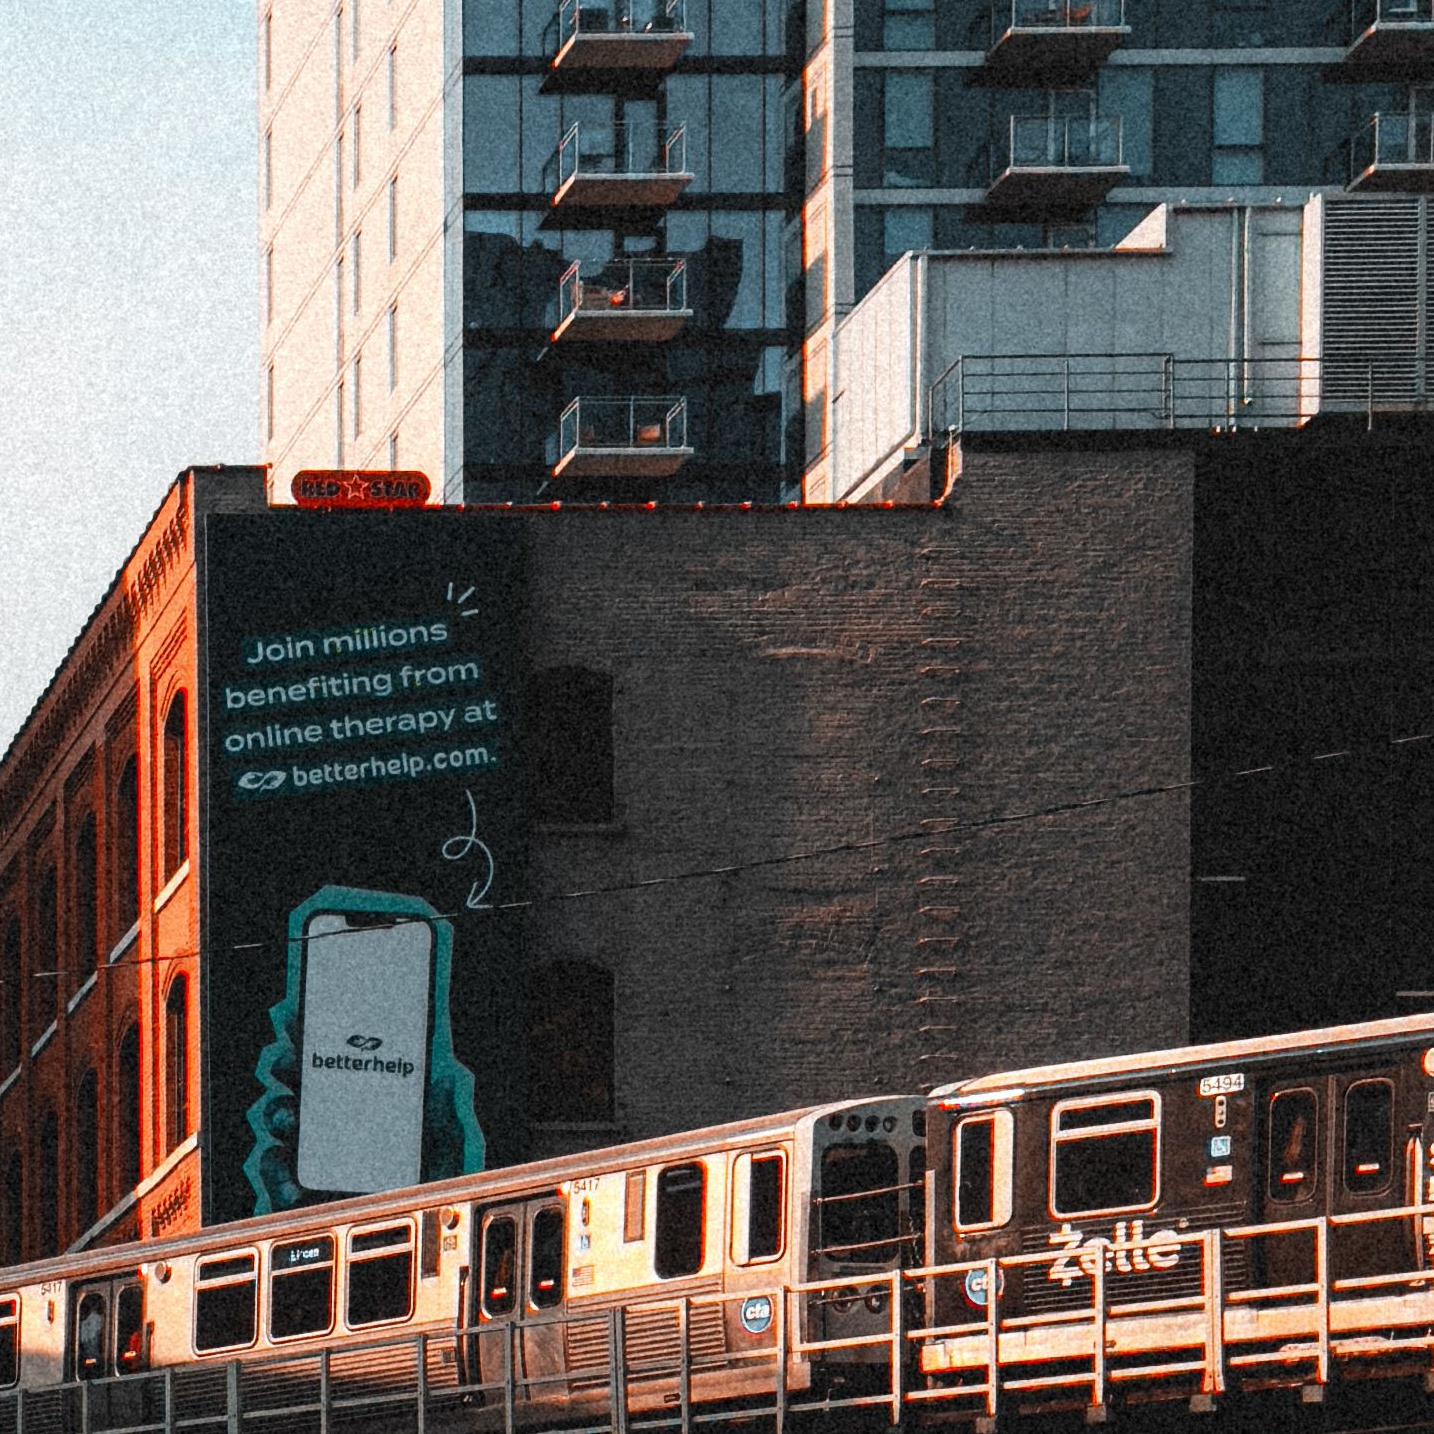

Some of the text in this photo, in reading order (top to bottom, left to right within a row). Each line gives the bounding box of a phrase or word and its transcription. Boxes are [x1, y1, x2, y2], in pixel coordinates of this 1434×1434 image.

[301, 479, 421, 498] RED STAR
[246, 620, 448, 665] Join millions
[225, 660, 479, 710] benefiting from
[224, 699, 497, 753] online therapy at
[292, 744, 497, 786] betterhelp.com.
[311, 1052, 415, 1079] betterhelp
[1201, 1075, 1243, 1093] 5494
[574, 1176, 600, 1194] 5417
[1048, 1219, 1182, 1286] Zelle
[745, 1302, 770, 1320] cta
